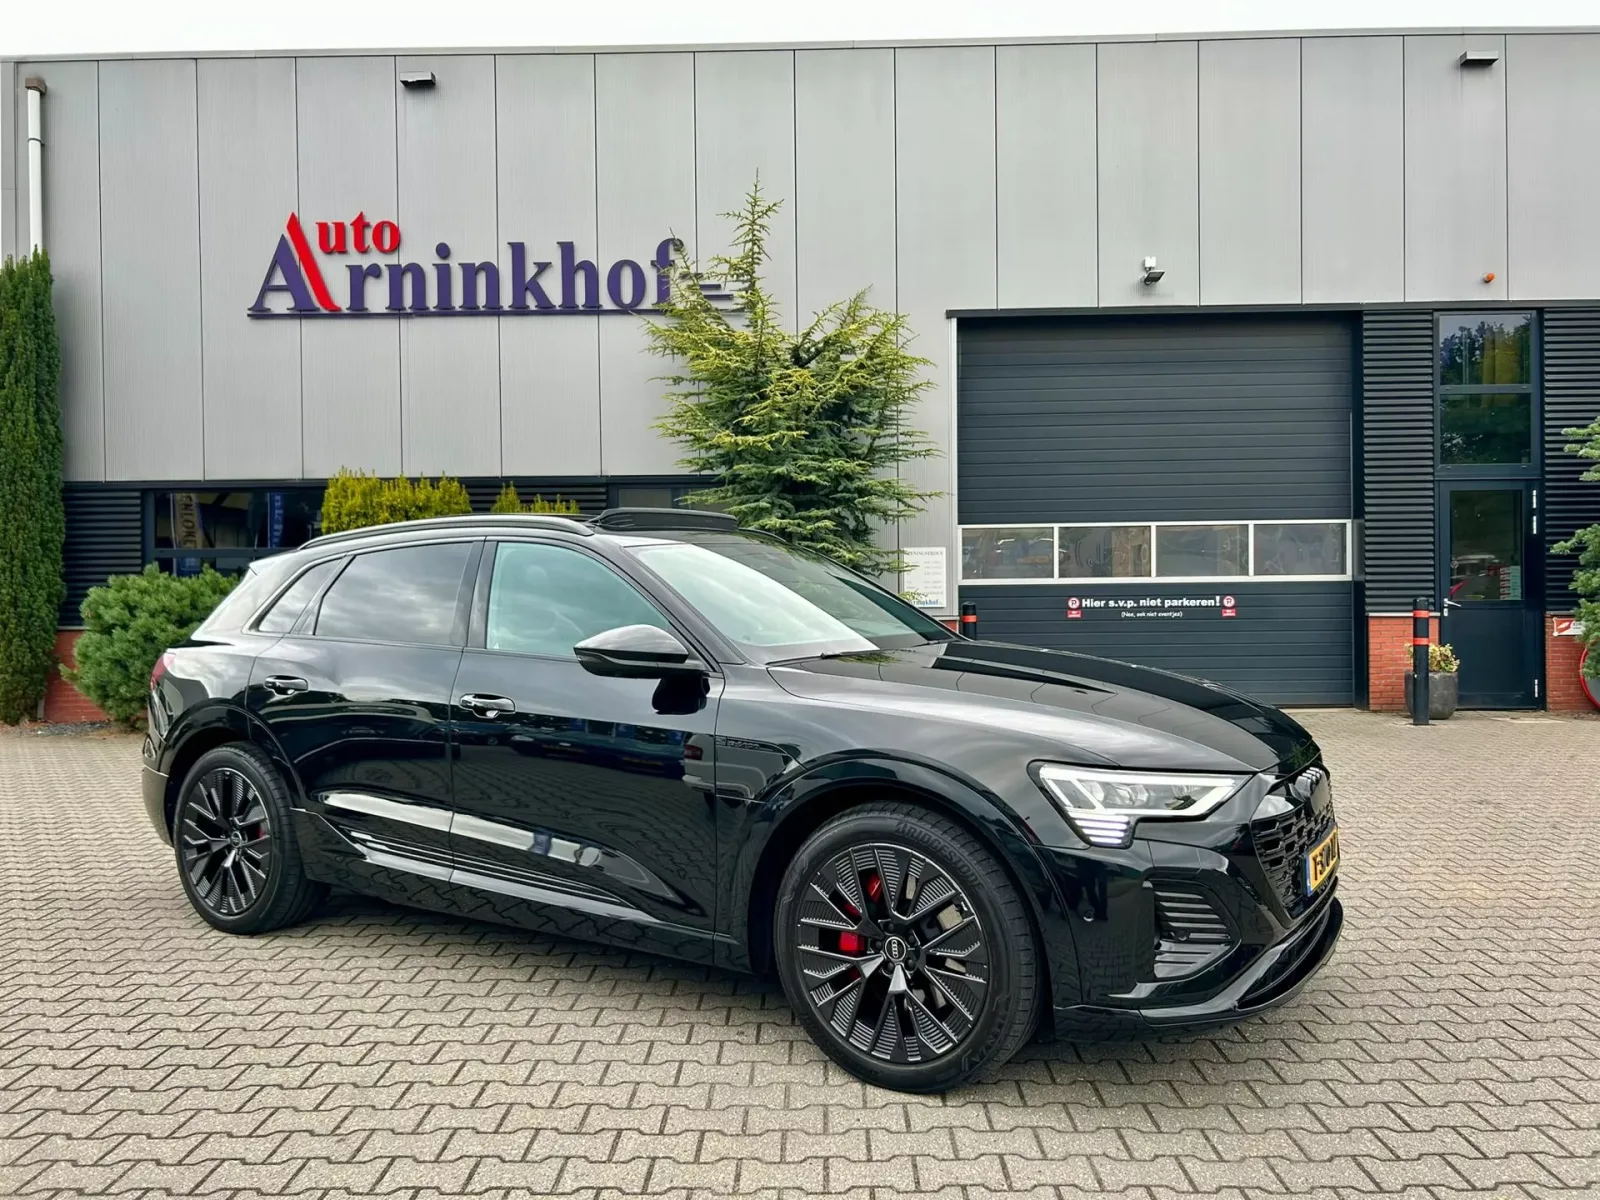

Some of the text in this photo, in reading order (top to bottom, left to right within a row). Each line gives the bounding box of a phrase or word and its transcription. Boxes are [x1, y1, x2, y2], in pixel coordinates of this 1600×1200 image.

[247, 233, 685, 313] Arninkhof
[1081, 596, 1220, 609] Hier s.v.p. niet parkeren!
[895, 821, 984, 893] BRIDGESTONE
